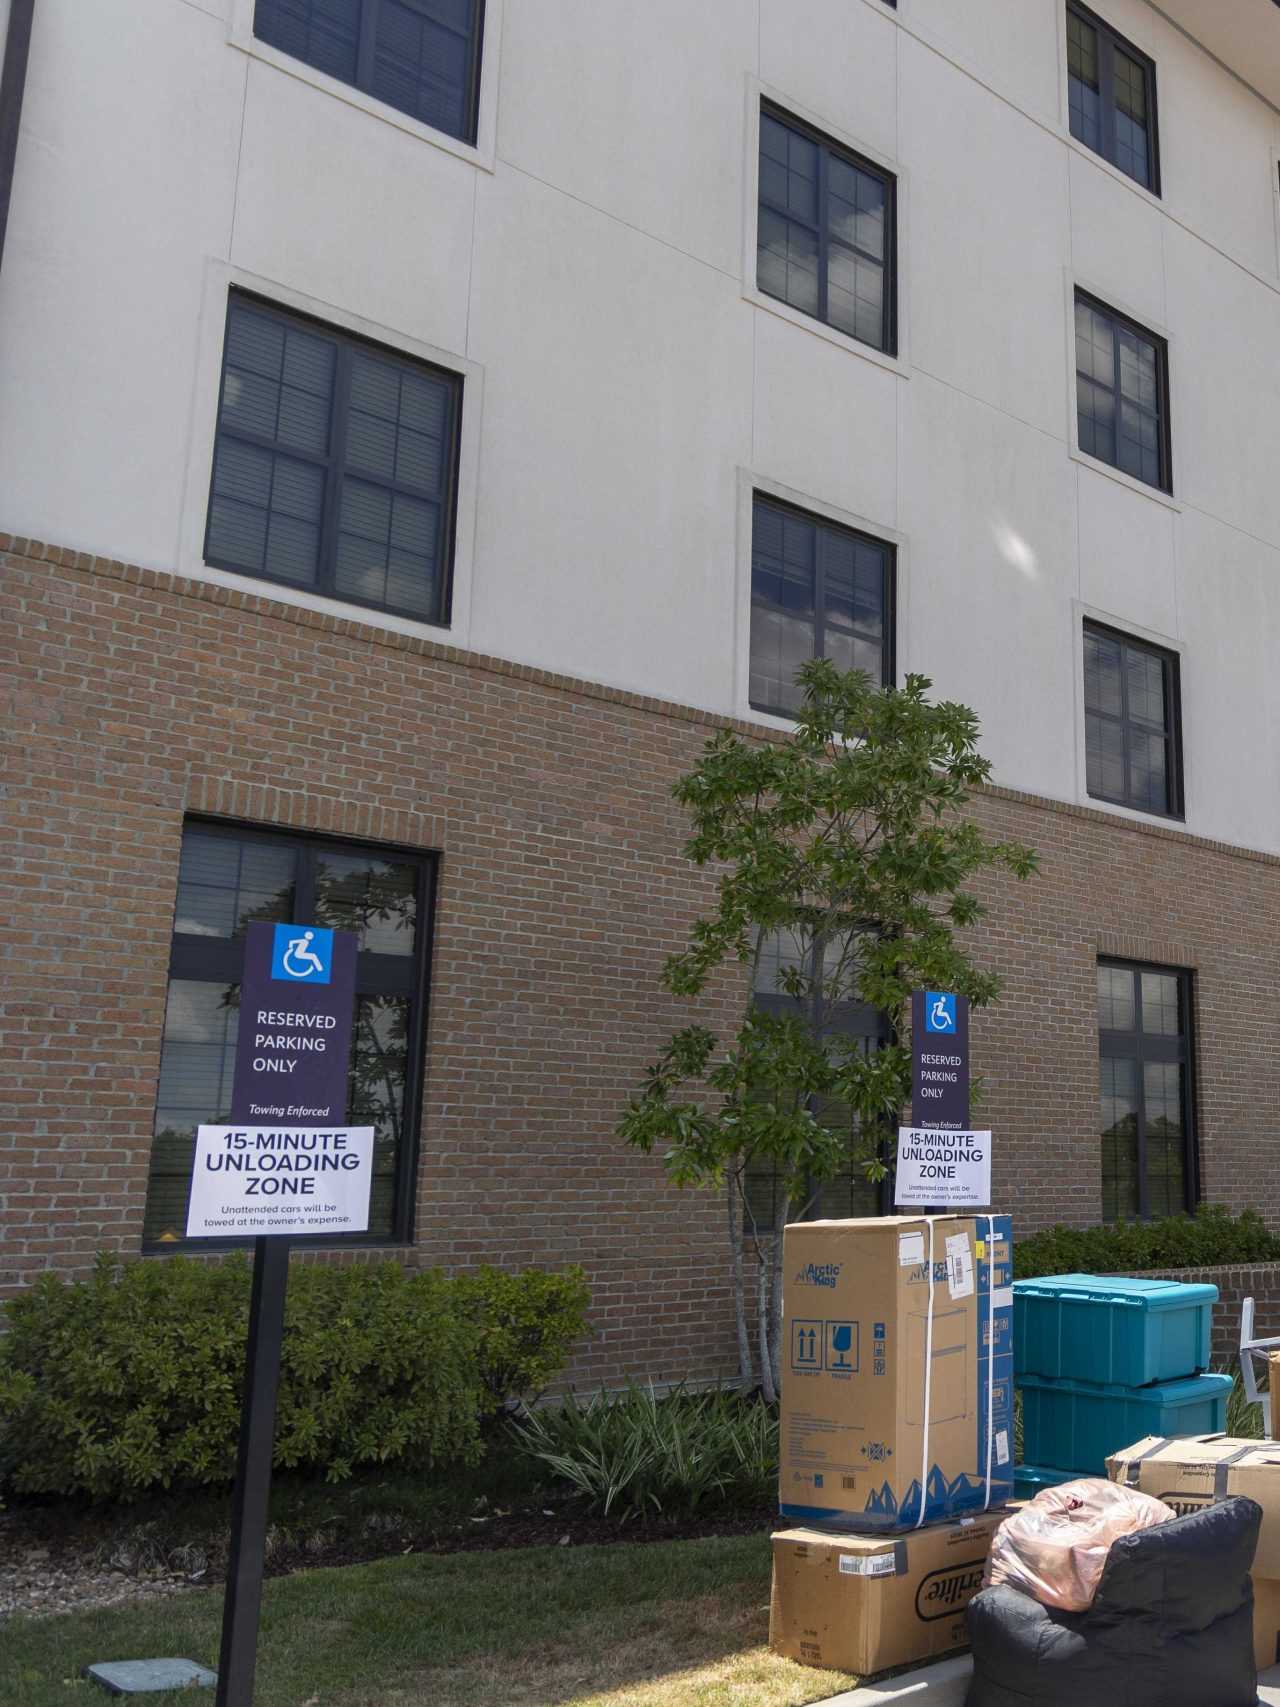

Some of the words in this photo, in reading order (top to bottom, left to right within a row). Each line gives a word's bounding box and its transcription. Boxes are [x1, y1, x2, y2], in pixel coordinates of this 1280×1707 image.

[257, 1010, 336, 1029] RESERVED
[255, 1033, 326, 1052] PARKING
[252, 1057, 297, 1073] ONLY
[921, 1054, 962, 1066] RESERVED
[921, 1070, 958, 1082] PARKING
[921, 1087, 944, 1098] ONLY
[249, 1103, 285, 1118] Towing
[286, 1105, 330, 1120] Enforced
[921, 1120, 940, 1130] Towing
[223, 1132, 347, 1151] 15-MINUTE
[909, 1132, 975, 1147] 15-MINUTE
[901, 1147, 984, 1162] UNLOADING
[205, 1153, 361, 1172] UNLOADING
[919, 1164, 956, 1178] ZONE
[244, 1177, 316, 1195] ZONE
[220, 1205, 279, 1214] Unattended
[280, 1206, 301, 1214] cars
[303, 1204, 321, 1213] will
[323, 1204, 337, 1213] be
[204, 1217, 235, 1227] towed
[237, 1218, 247, 1227] at
[249, 1217, 265, 1226] the
[267, 1216, 305, 1226] owner's
[307, 1216, 352, 1225] expense.
[807, 1263, 840, 1275] Arctic
[814, 1274, 837, 1288] King
